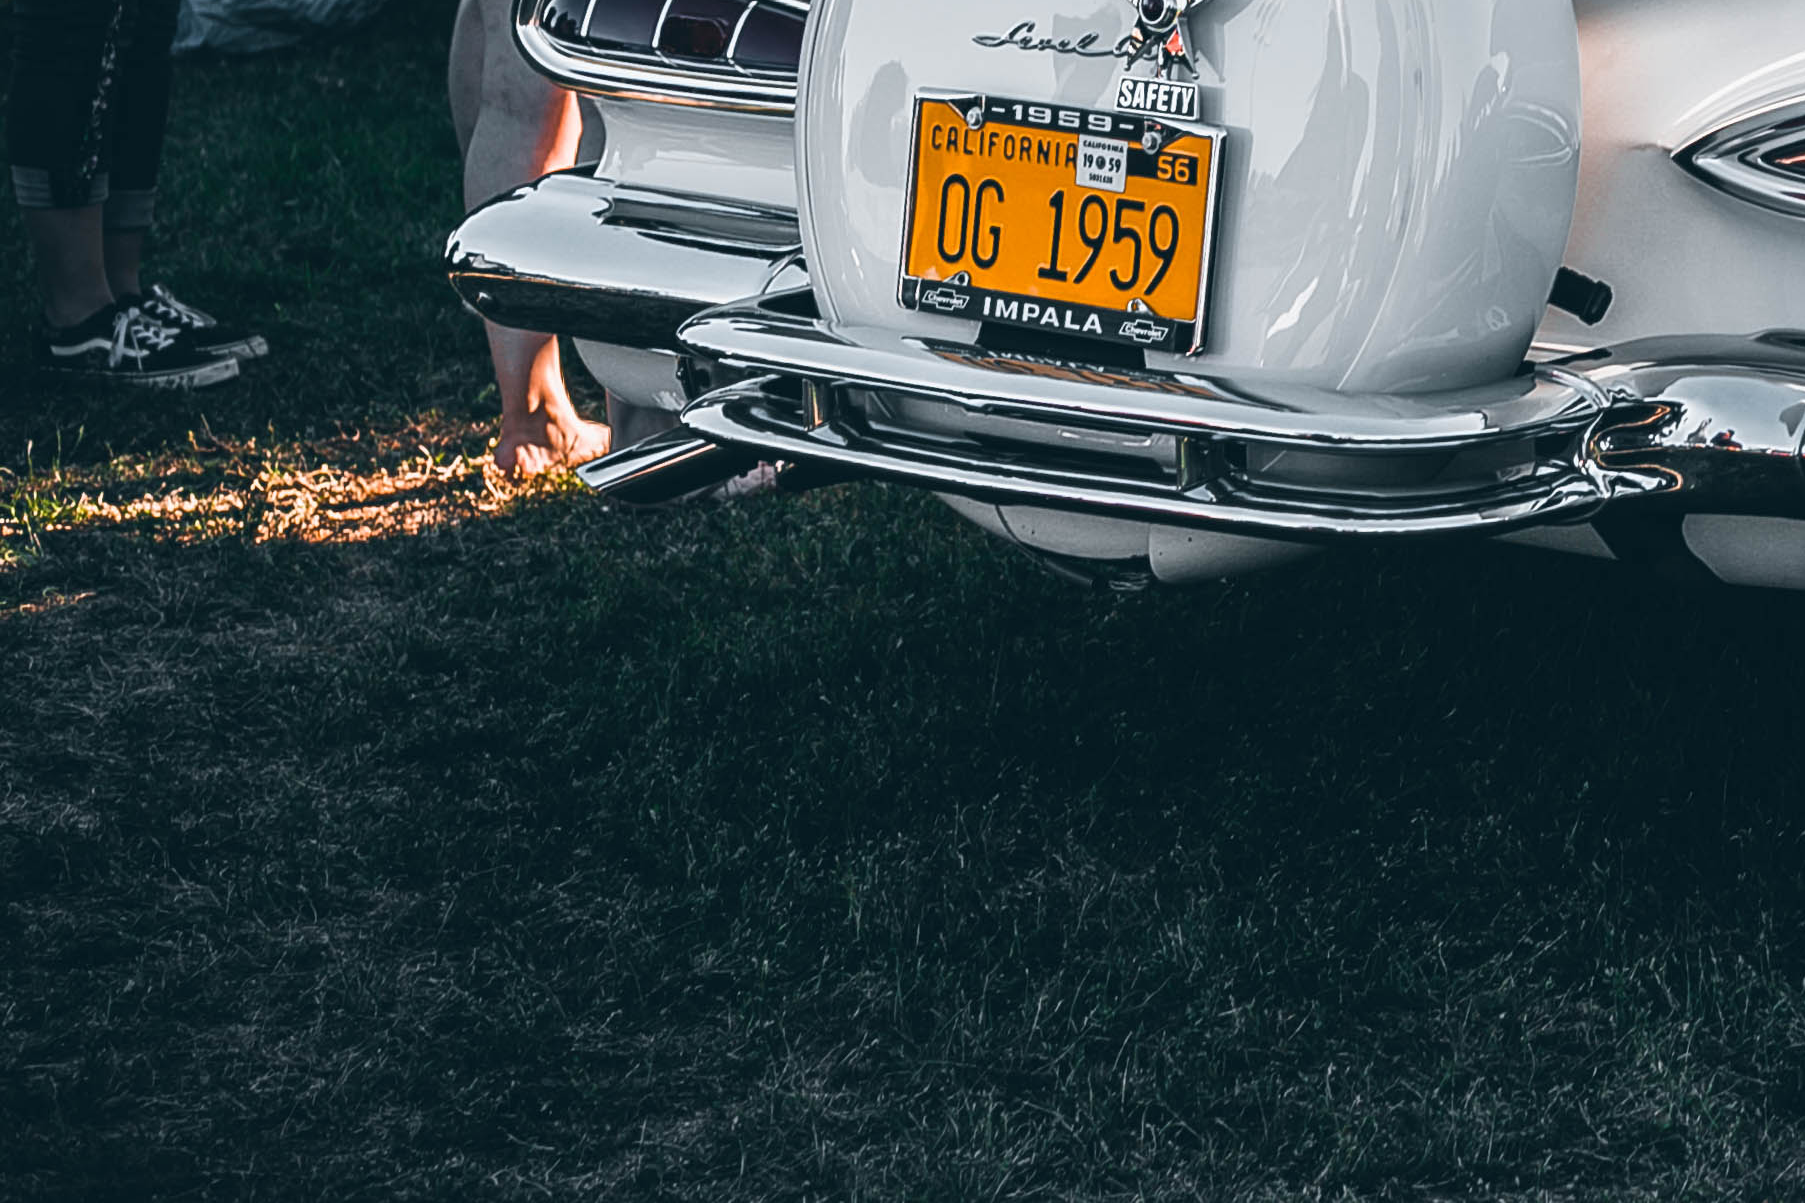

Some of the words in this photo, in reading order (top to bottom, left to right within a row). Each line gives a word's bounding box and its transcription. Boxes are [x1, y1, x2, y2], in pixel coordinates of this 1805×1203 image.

[1118, 78, 1194, 117] SAFETY
[930, 123, 1077, 164] CALIFORNIA
[1156, 156, 1191, 182] 56
[1082, 139, 1125, 154] CALIFORNIA
[1082, 153, 1095, 169] 19
[1107, 157, 1122, 173] 59
[937, 172, 1006, 270] OG
[1036, 188, 1181, 297] 1959
[926, 292, 965, 308] Chevrolet
[982, 295, 1103, 335] IMPALA
[1123, 323, 1163, 340] Chevrolet
